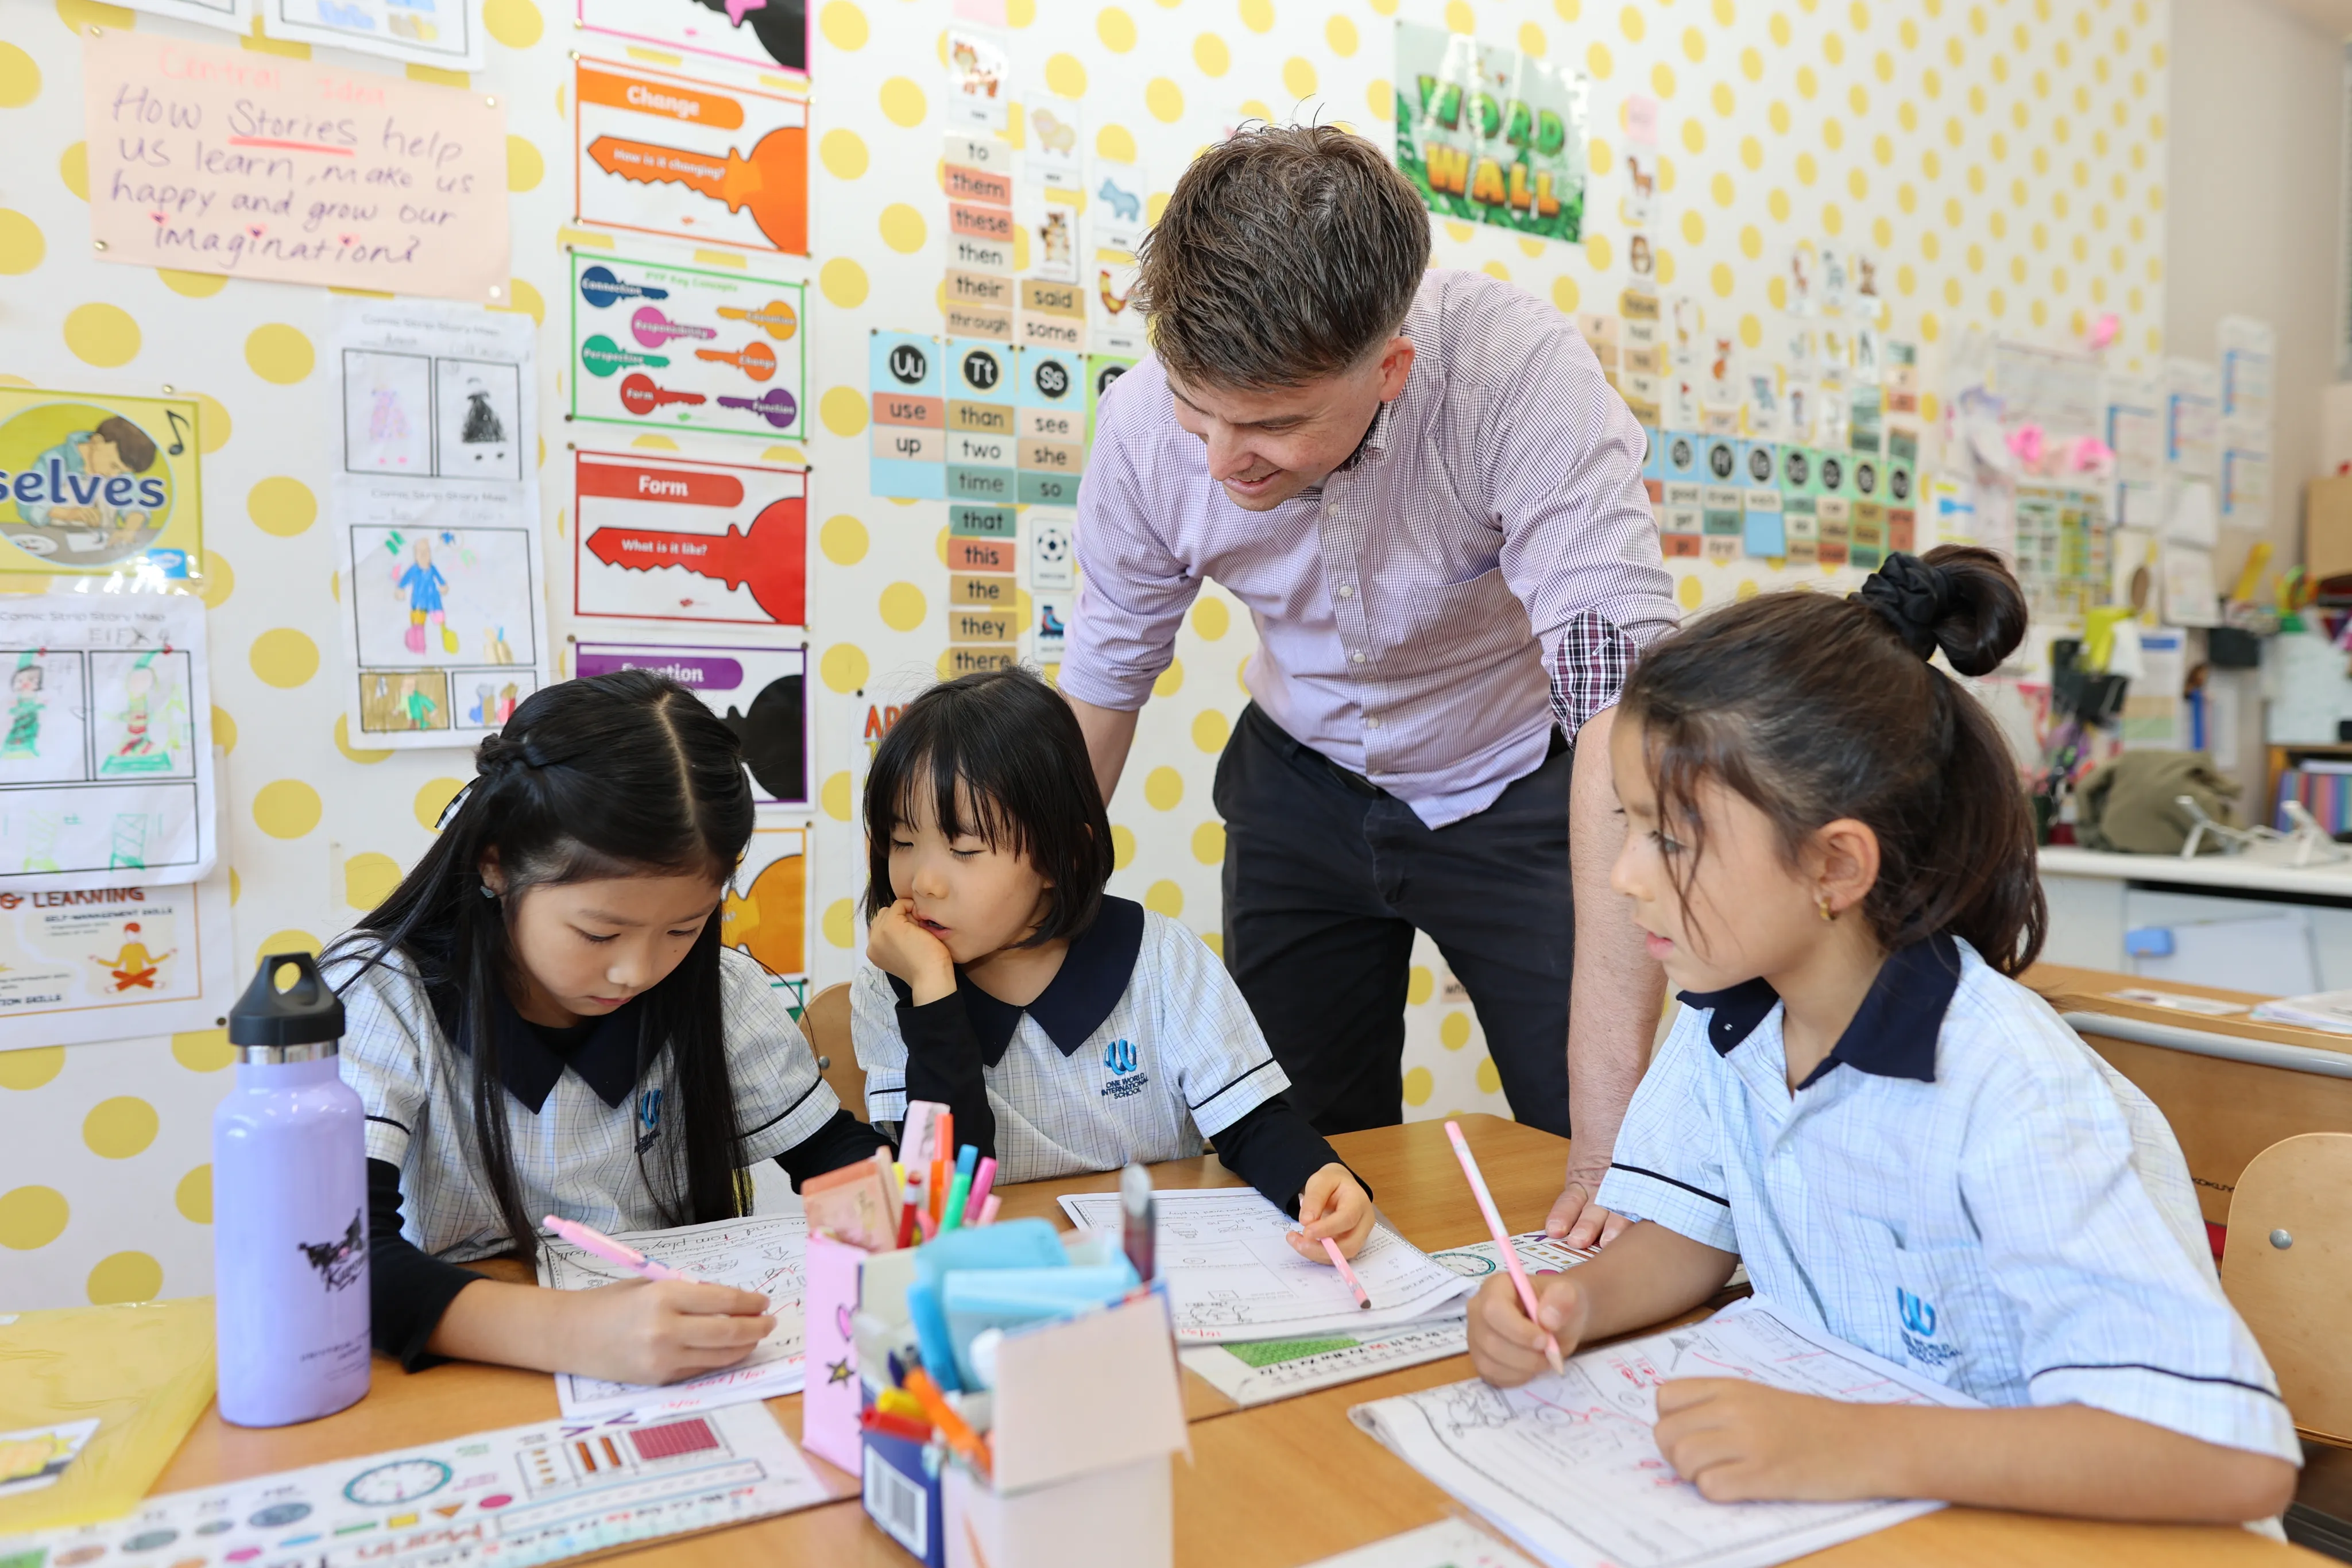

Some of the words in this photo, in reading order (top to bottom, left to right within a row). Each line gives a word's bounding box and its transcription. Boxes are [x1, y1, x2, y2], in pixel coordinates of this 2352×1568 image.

[158, 45, 282, 92] Central
[316, 77, 388, 108] Idea
[626, 85, 700, 118] Change
[1417, 73, 1565, 157] WORD
[111, 83, 202, 130] How
[229, 99, 358, 146] Stories
[383, 117, 463, 168] help
[613, 148, 641, 164] How
[968, 143, 988, 161] to
[118, 136, 171, 168] us
[321, 163, 413, 188] make
[437, 173, 474, 194] us
[953, 175, 1004, 199] them
[1424, 141, 1560, 218] WALL
[110, 171, 216, 218] happy
[231, 191, 295, 221] and
[308, 197, 378, 231] grow
[400, 207, 457, 226] our
[956, 208, 1008, 233] these
[959, 243, 1003, 265] then
[581, 278, 642, 295] Connection
[957, 276, 1003, 298] their
[1034, 289, 1072, 308] said
[635, 320, 708, 338] Responsibility
[950, 311, 1009, 332] through
[1026, 322, 1077, 342] some
[583, 348, 644, 365] Perspective
[739, 355, 776, 370] Change
[968, 358, 993, 384] Tt
[1040, 366, 1065, 391] Ss
[626, 388, 654, 401] Form
[752, 401, 795, 415] Function
[890, 403, 926, 420] use
[961, 407, 1004, 428] than
[1035, 417, 1069, 433] see
[896, 437, 920, 457] up
[962, 440, 1001, 459] two
[1034, 447, 1067, 466] she
[639, 475, 689, 497] Form
[960, 473, 1004, 492] time
[1040, 481, 1062, 498] so
[963, 512, 1003, 531] that
[622, 539, 653, 553] What
[656, 541, 667, 553] is
[670, 542, 679, 554] it
[682, 543, 707, 556] like?
[965, 547, 999, 566] this
[968, 580, 1000, 598] the
[961, 617, 1005, 638] they
[956, 652, 1010, 671] there
[1101, 1077, 1148, 1096] INTERNATIONAL
[1106, 1080, 1120, 1089] ONE
[1121, 1073, 1144, 1085] WORLD
[1114, 1087, 1142, 1099] SCHOOL
